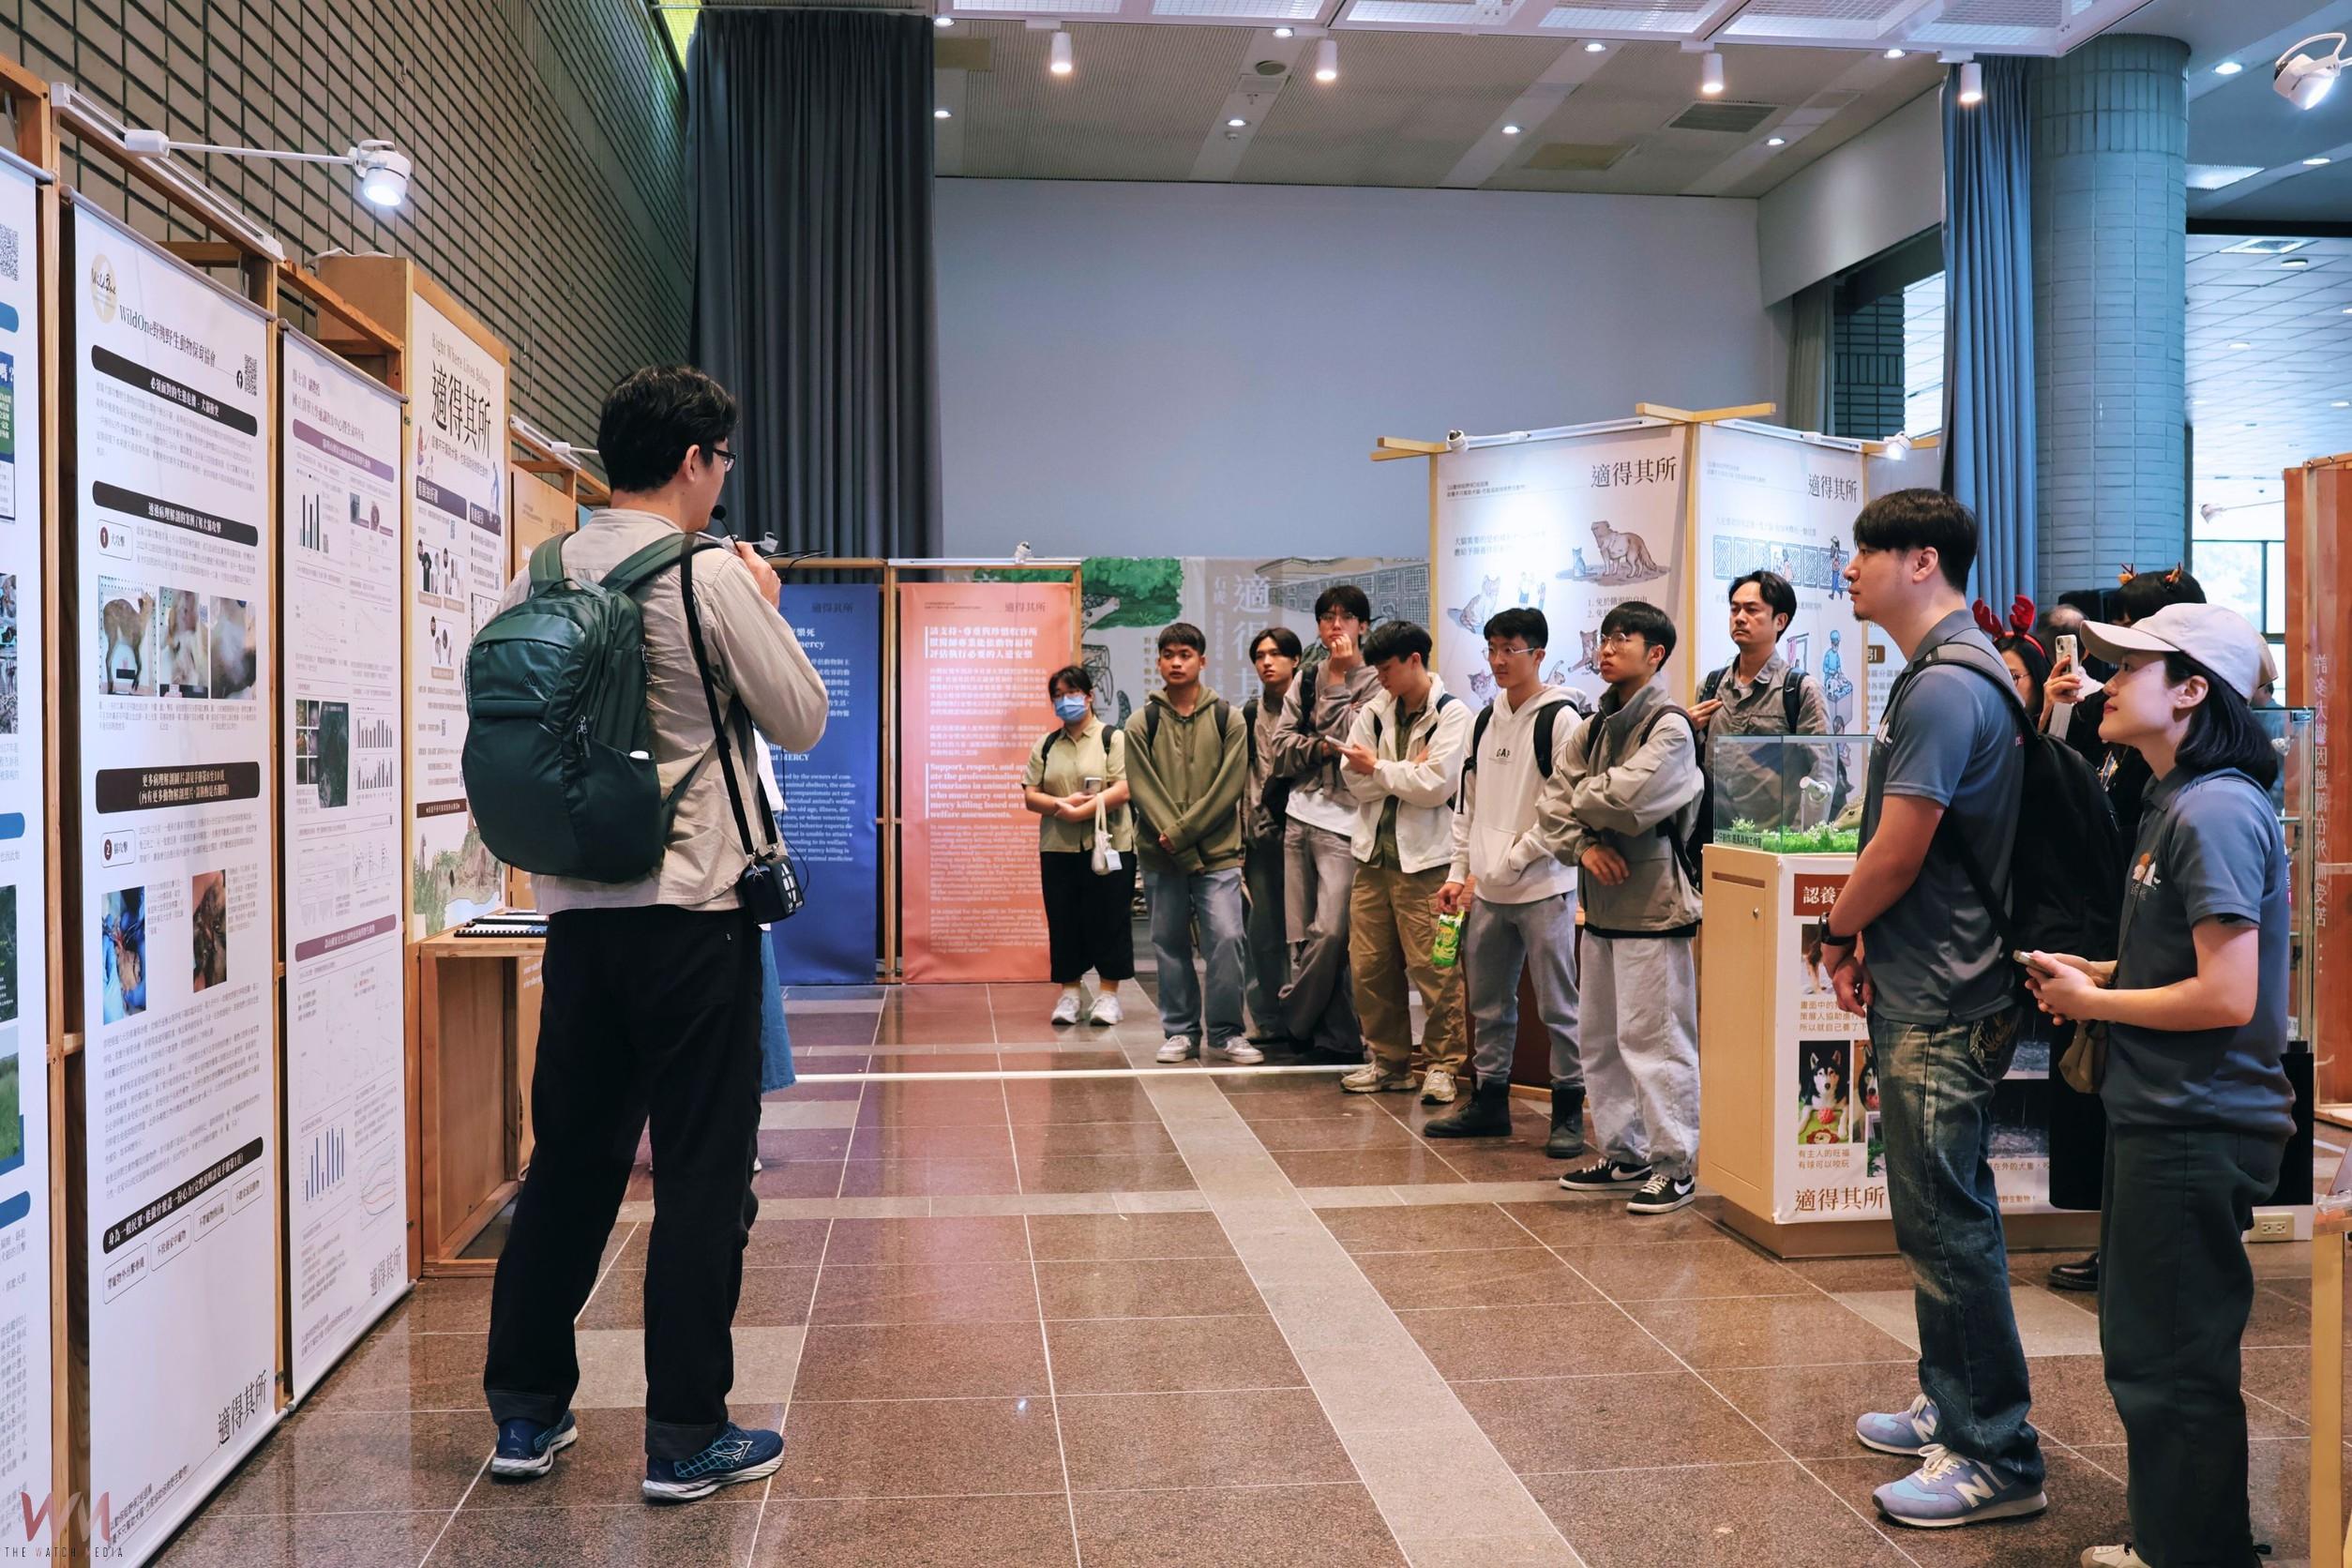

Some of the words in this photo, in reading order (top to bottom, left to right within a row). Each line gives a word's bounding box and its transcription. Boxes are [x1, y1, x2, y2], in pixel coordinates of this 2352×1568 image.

[431, 360, 491, 460] 適得其所
[1591, 456, 1678, 489] 適得其所
[1807, 473, 1859, 504] 適得其所
[1496, 747, 1511, 759] GAP
[930, 763, 966, 776] Support,
[967, 763, 998, 776] respect,
[1000, 763, 1015, 773] and
[944, 772, 957, 782] the
[929, 792, 947, 800] who
[929, 810, 960, 820] welfare
[957, 801, 984, 812] killing
[1802, 886, 1843, 904] 認養
[1794, 1185, 1885, 1212] 適得其所
[370, 1244, 401, 1297] 適得其所
[218, 1369, 267, 1449] 適得其所
